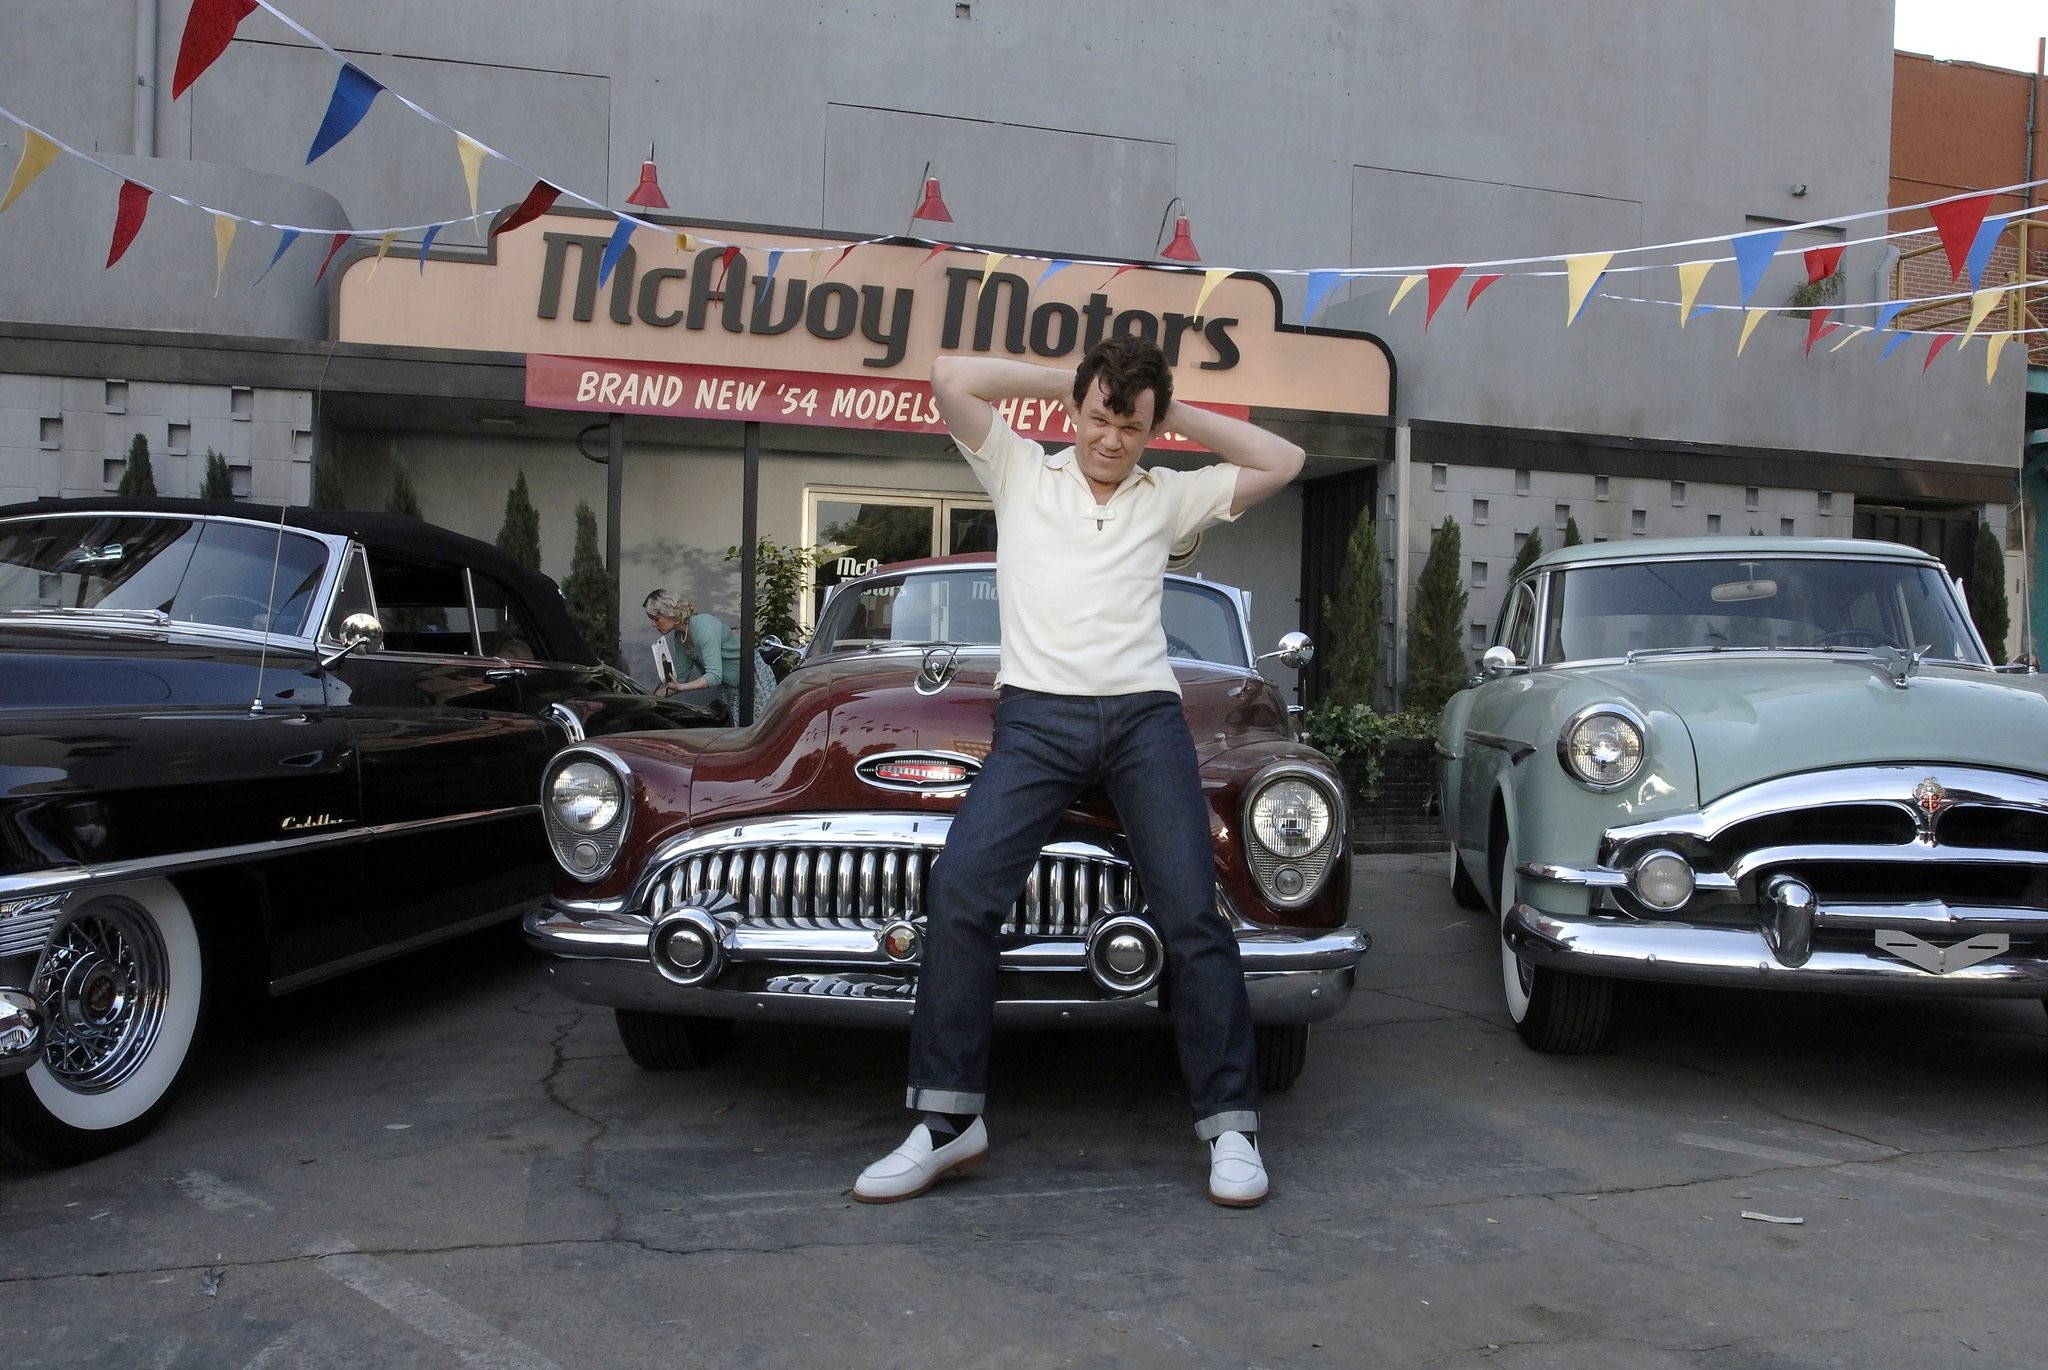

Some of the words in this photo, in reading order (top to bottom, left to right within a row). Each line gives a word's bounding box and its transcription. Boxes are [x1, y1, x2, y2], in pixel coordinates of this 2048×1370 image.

[537, 231, 914, 368] McAvoy
[576, 370, 684, 407] BRAND
[694, 378, 766, 412] NEW
[776, 384, 818, 417] '54
[830, 387, 947, 425] MODELS
